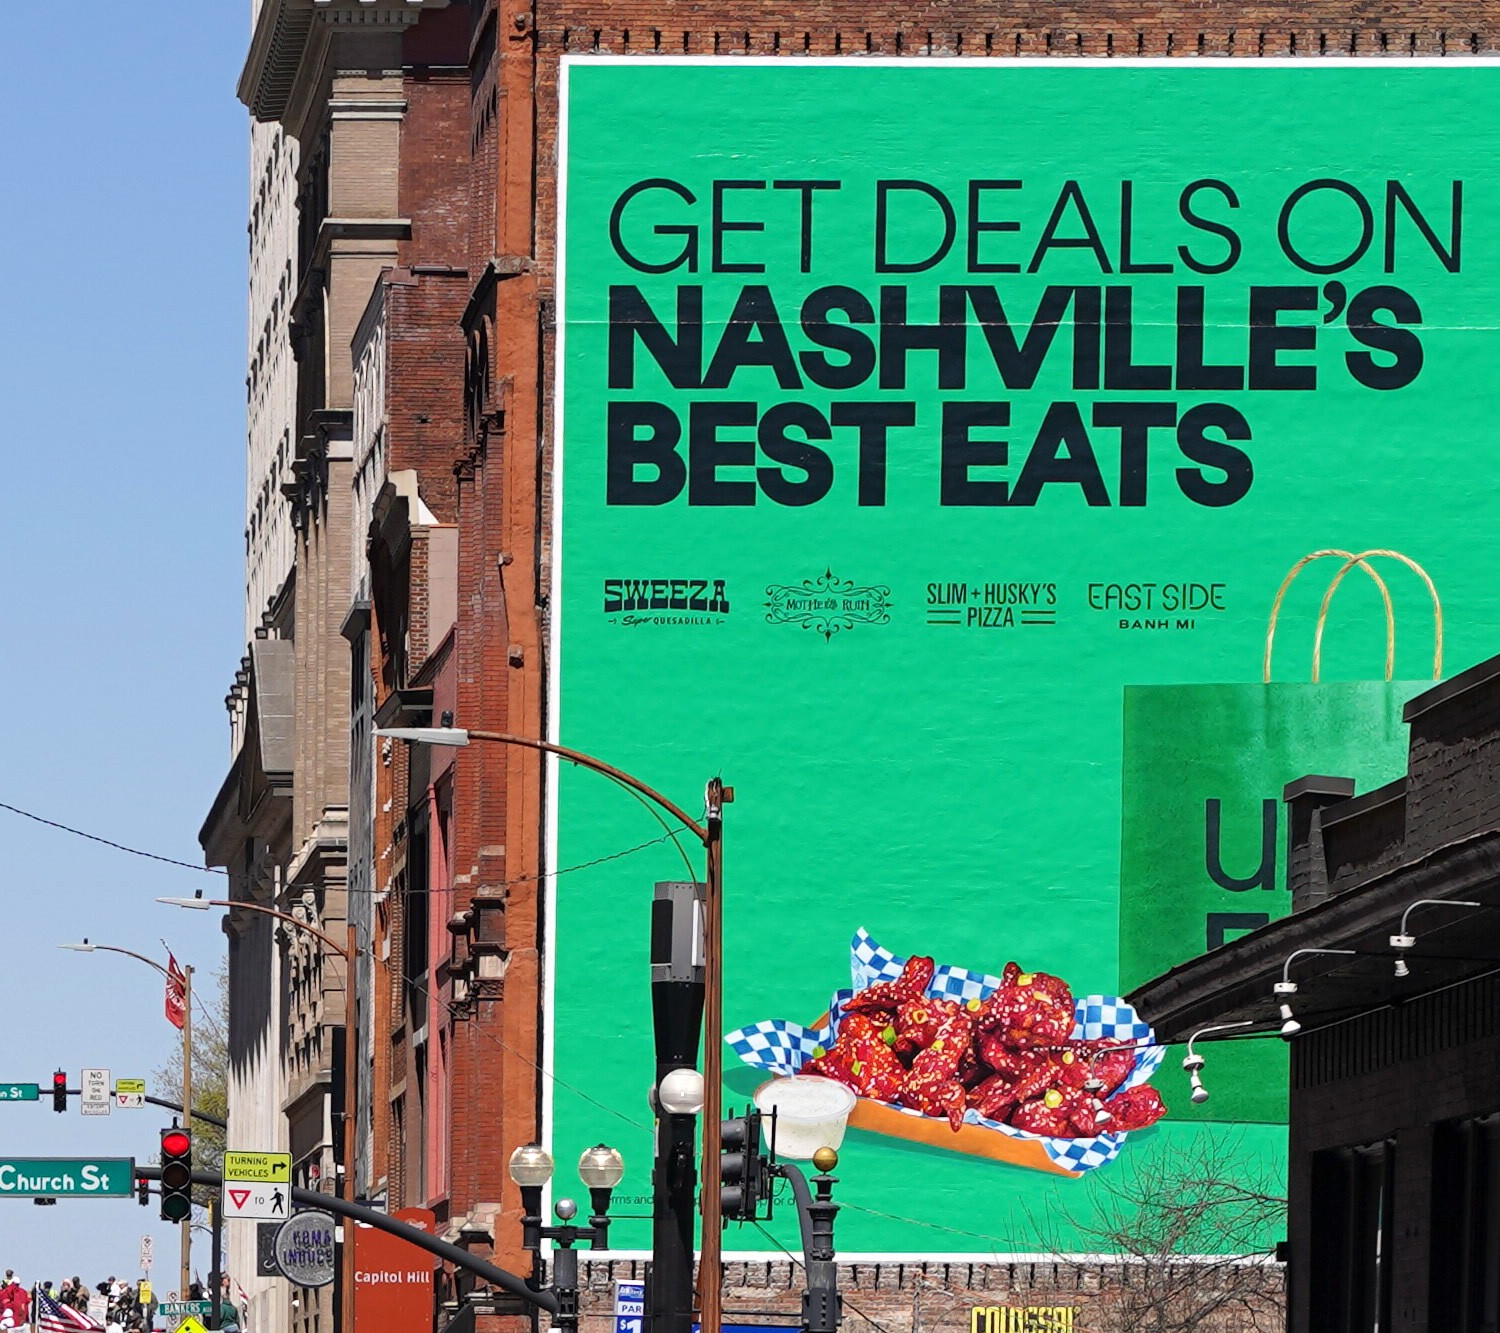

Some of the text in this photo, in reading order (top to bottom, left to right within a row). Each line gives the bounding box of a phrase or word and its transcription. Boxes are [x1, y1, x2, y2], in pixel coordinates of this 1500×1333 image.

[609, 178, 1462, 274] GET DEALS ON
[607, 281, 1424, 391] NASHVILLE'S
[607, 401, 1254, 508] BEST EATS
[604, 579, 730, 614] SWEEZA
[927, 582, 1057, 605] SLIM HUSKY'S
[1088, 582, 1226, 611] EAST SIDE
[967, 607, 1014, 628] PIZZA
[1119, 619, 1195, 630] BANH MI
[10, 1087, 22, 1098] St
[229, 1156, 268, 1166] TURNING
[80, 1164, 109, 1190] St
[228, 1168, 269, 1178] VEHICLES
[254, 1197, 264, 1205] TO
[355, 1269, 430, 1284] Capitol Hill
[164, 1304, 200, 1313] BANKERS
